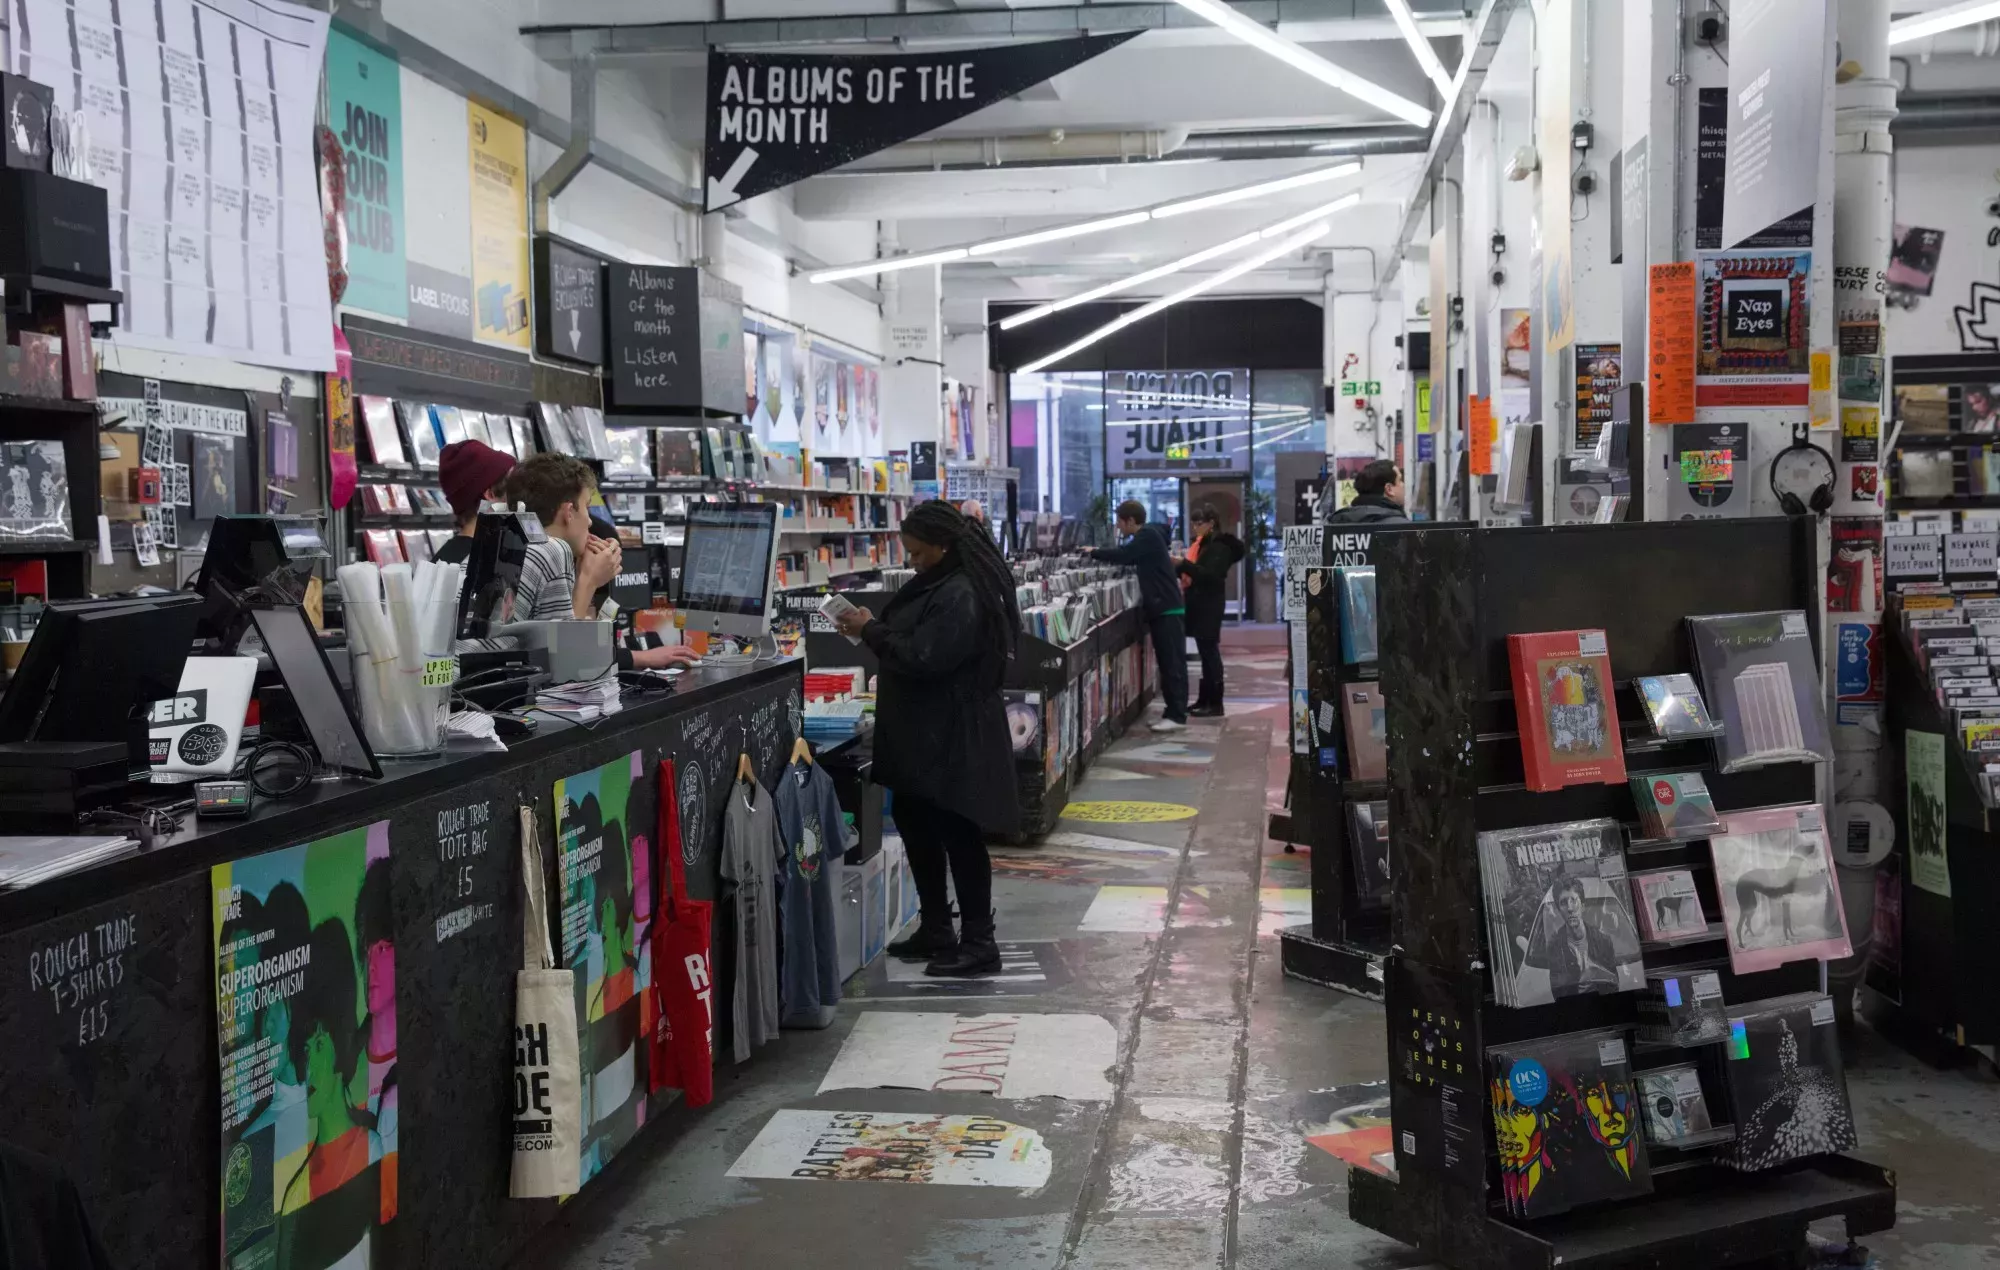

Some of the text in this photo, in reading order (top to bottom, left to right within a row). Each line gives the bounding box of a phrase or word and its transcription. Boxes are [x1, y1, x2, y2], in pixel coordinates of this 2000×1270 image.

[721, 62, 975, 104] ALBUMS OF THE
[342, 101, 389, 161] JOIN
[719, 107, 828, 144] MONTH
[629, 269, 675, 290] Albums
[410, 284, 469, 316] LABEL FOCUS
[629, 296, 676, 316] of the
[1738, 299, 1772, 314] Nap
[634, 319, 671, 336] month
[1735, 316, 1774, 333] Eyes
[624, 347, 678, 366] Listen
[192, 403, 202, 424] OF
[205, 408, 220, 430] THE
[223, 411, 246, 433] WEEK
[1285, 528, 1322, 550] JAMIE
[1332, 533, 1371, 551] NEW
[1893, 542, 1932, 552] NEW WAVE
[1951, 539, 1990, 549] NEW WAVE
[1288, 546, 1321, 555] STEWART
[1334, 552, 1366, 567] AND
[1891, 560, 1934, 570] POST PUNK
[1950, 558, 1992, 568] POST PUNK
[615, 572, 648, 587] THINKING
[786, 597, 801, 608] PLAY
[427, 662, 437, 673] LP
[423, 673, 449, 685] 10 FOR
[147, 696, 199, 722] ER
[183, 751, 216, 760] HABITS
[438, 801, 490, 839] ROUGH TRADE
[439, 829, 487, 862] TOTE BAG
[560, 835, 603, 872] SUPERORGANISM
[1516, 837, 1602, 866] NIGHT SHOP
[458, 865, 473, 897] £5
[560, 854, 602, 892] SUPERORGANISM
[218, 884, 241, 903] ROUGH
[219, 901, 242, 922] TRADE
[472, 903, 493, 922] WHITE
[30, 914, 137, 991] ROUGH TRADE
[220, 929, 275, 957] ALBUM OF THE MONTH
[220, 944, 311, 998] SUPERORGANISM
[50, 954, 124, 1014] T-SHIRTS
[221, 971, 304, 1025] SUPERORGANISM
[79, 1000, 108, 1046] £15
[256, 1036, 271, 1051] MEETS
[238, 1049, 270, 1072] POSSIBILITIES
[254, 1065, 265, 1078] AND
[265, 1057, 279, 1072] SHINY
[1515, 1069, 1540, 1085] OCS
[223, 1085, 276, 1119] VOCALS AND MAVERICK
[223, 1120, 231, 1132] POP
[791, 1113, 874, 1178] BATTLES
